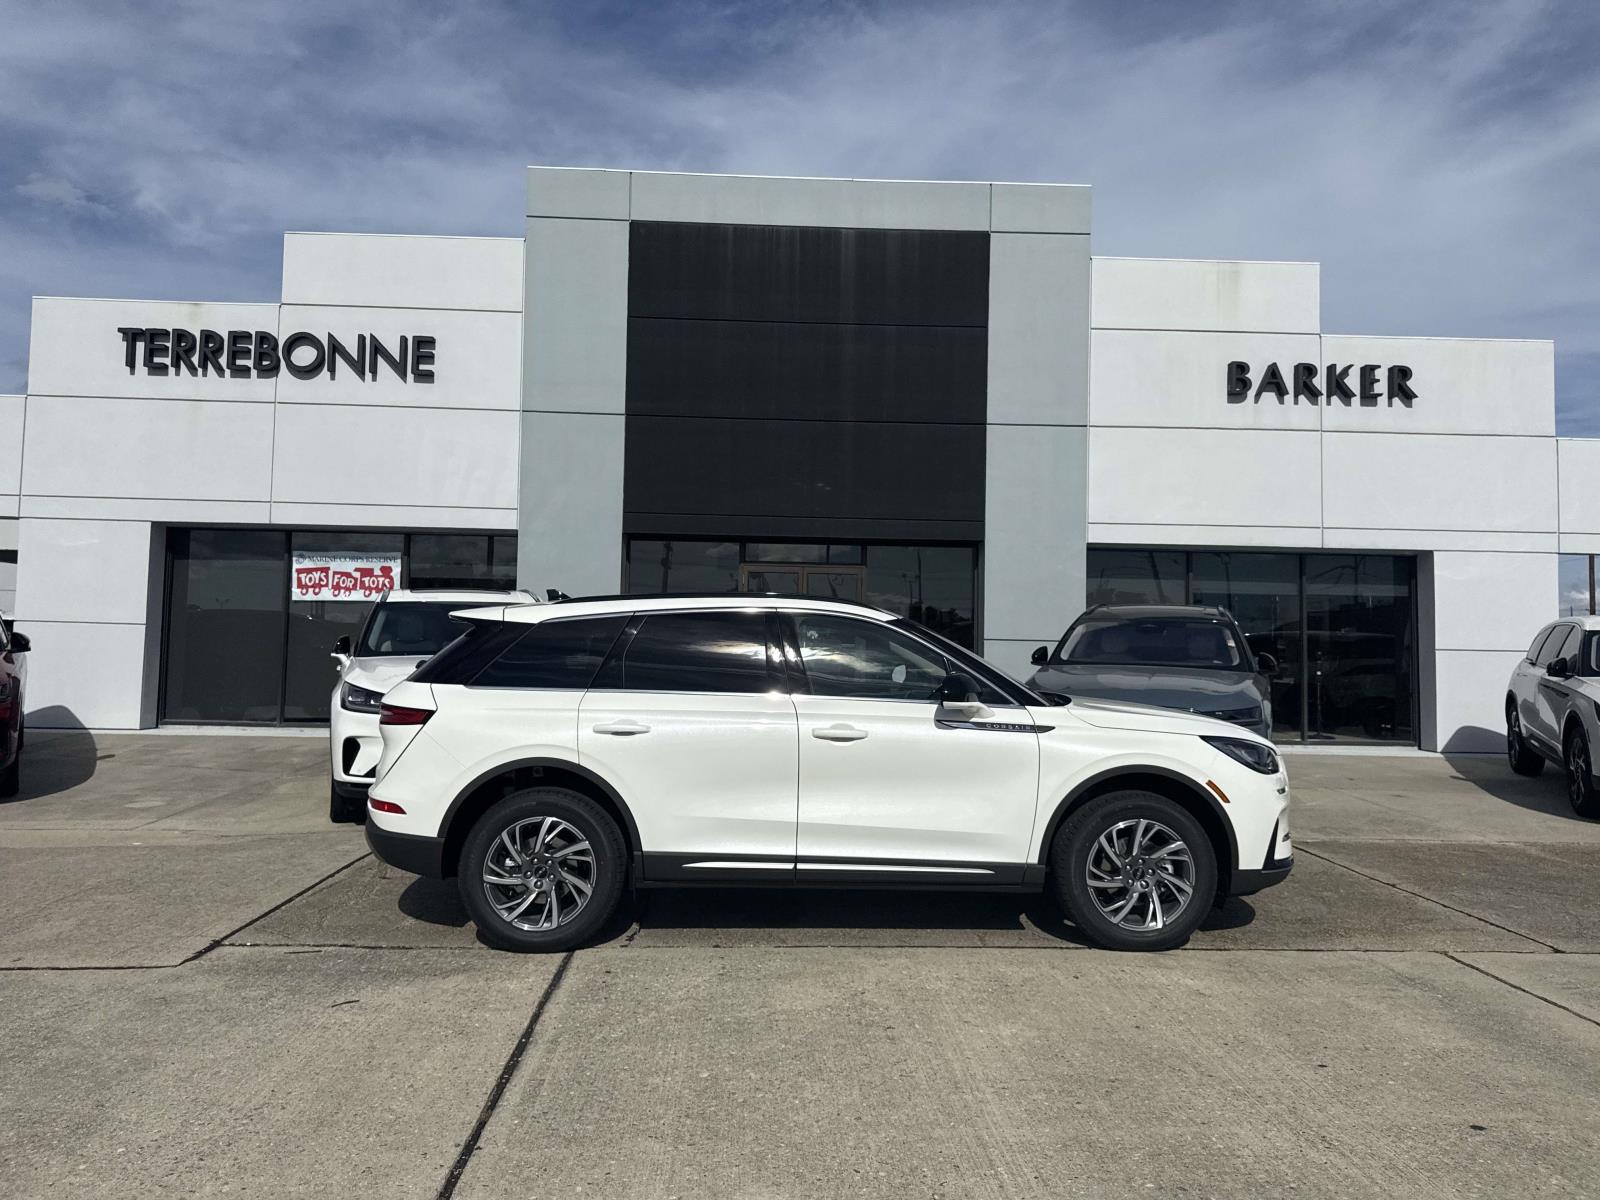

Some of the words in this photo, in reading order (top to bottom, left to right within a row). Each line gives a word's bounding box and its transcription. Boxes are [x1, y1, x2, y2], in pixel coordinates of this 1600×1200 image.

[117, 327, 436, 383] TERREBONNE
[1226, 361, 1419, 407] BARKER
[307, 555, 336, 563] MARINE
[338, 555, 365, 563] CORPS
[366, 555, 398, 564] RESERVE
[299, 570, 328, 586] TOYS
[333, 575, 355, 588] FOR
[361, 576, 391, 589] TOTS
